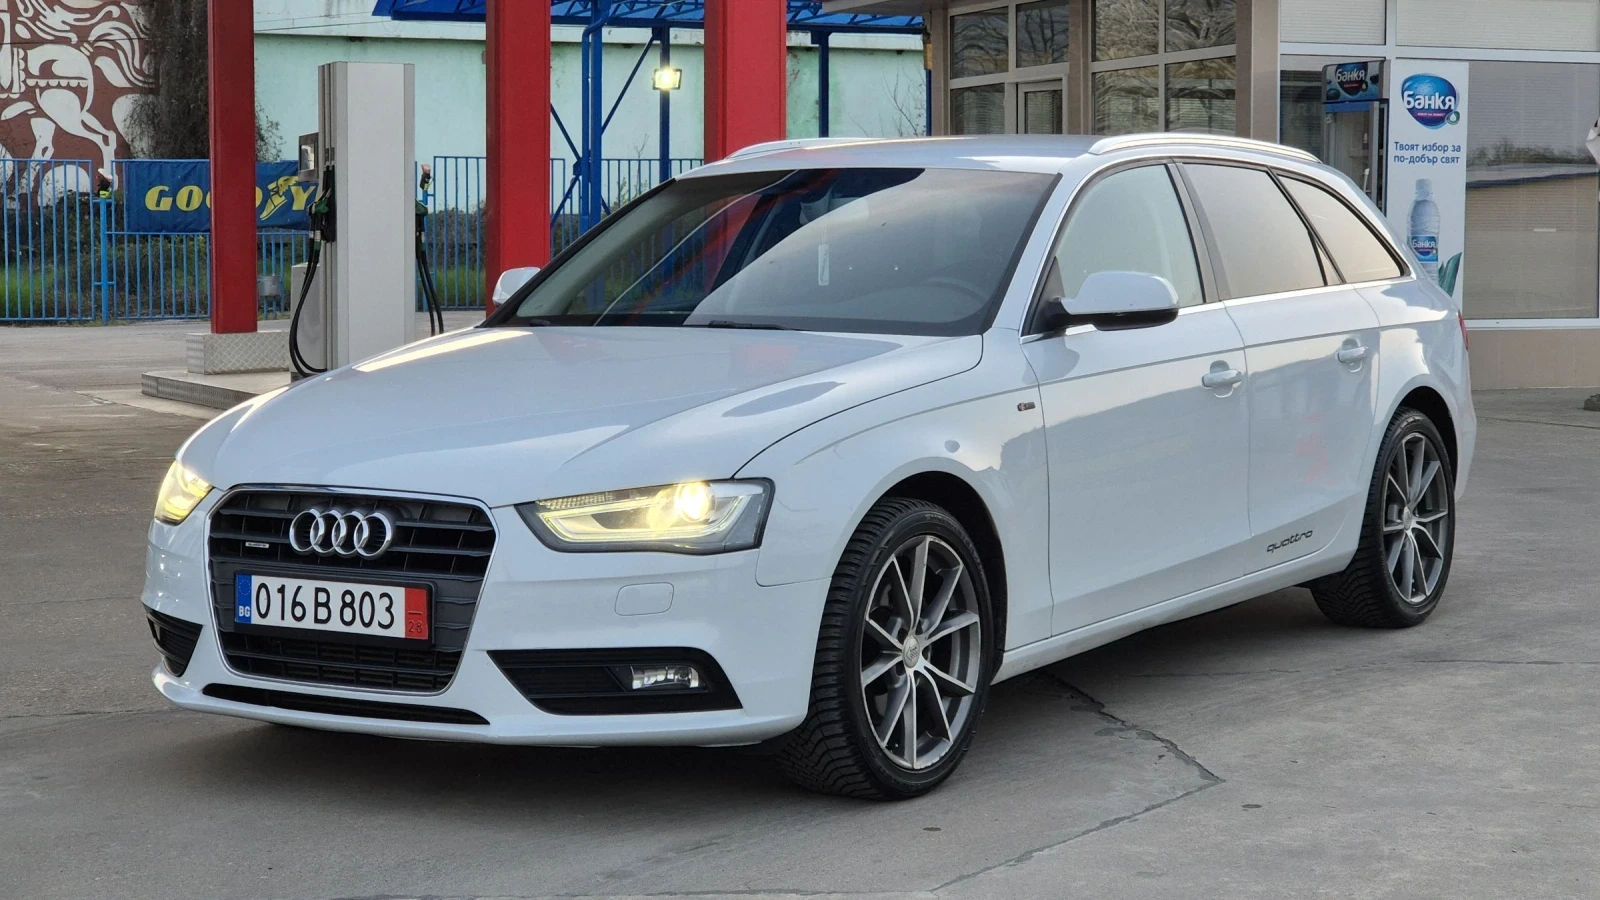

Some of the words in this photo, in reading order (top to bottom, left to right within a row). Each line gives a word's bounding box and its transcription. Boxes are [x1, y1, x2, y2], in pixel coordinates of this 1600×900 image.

[1394, 141, 1420, 151] Твоят
[1422, 142, 1449, 154] избор
[1451, 144, 1462, 152] за
[1393, 153, 1438, 165] по-добър
[1440, 156, 1460, 164] свят
[1266, 530, 1313, 553] quattro
[238, 605, 251, 618] BG
[408, 619, 423, 634] 28
